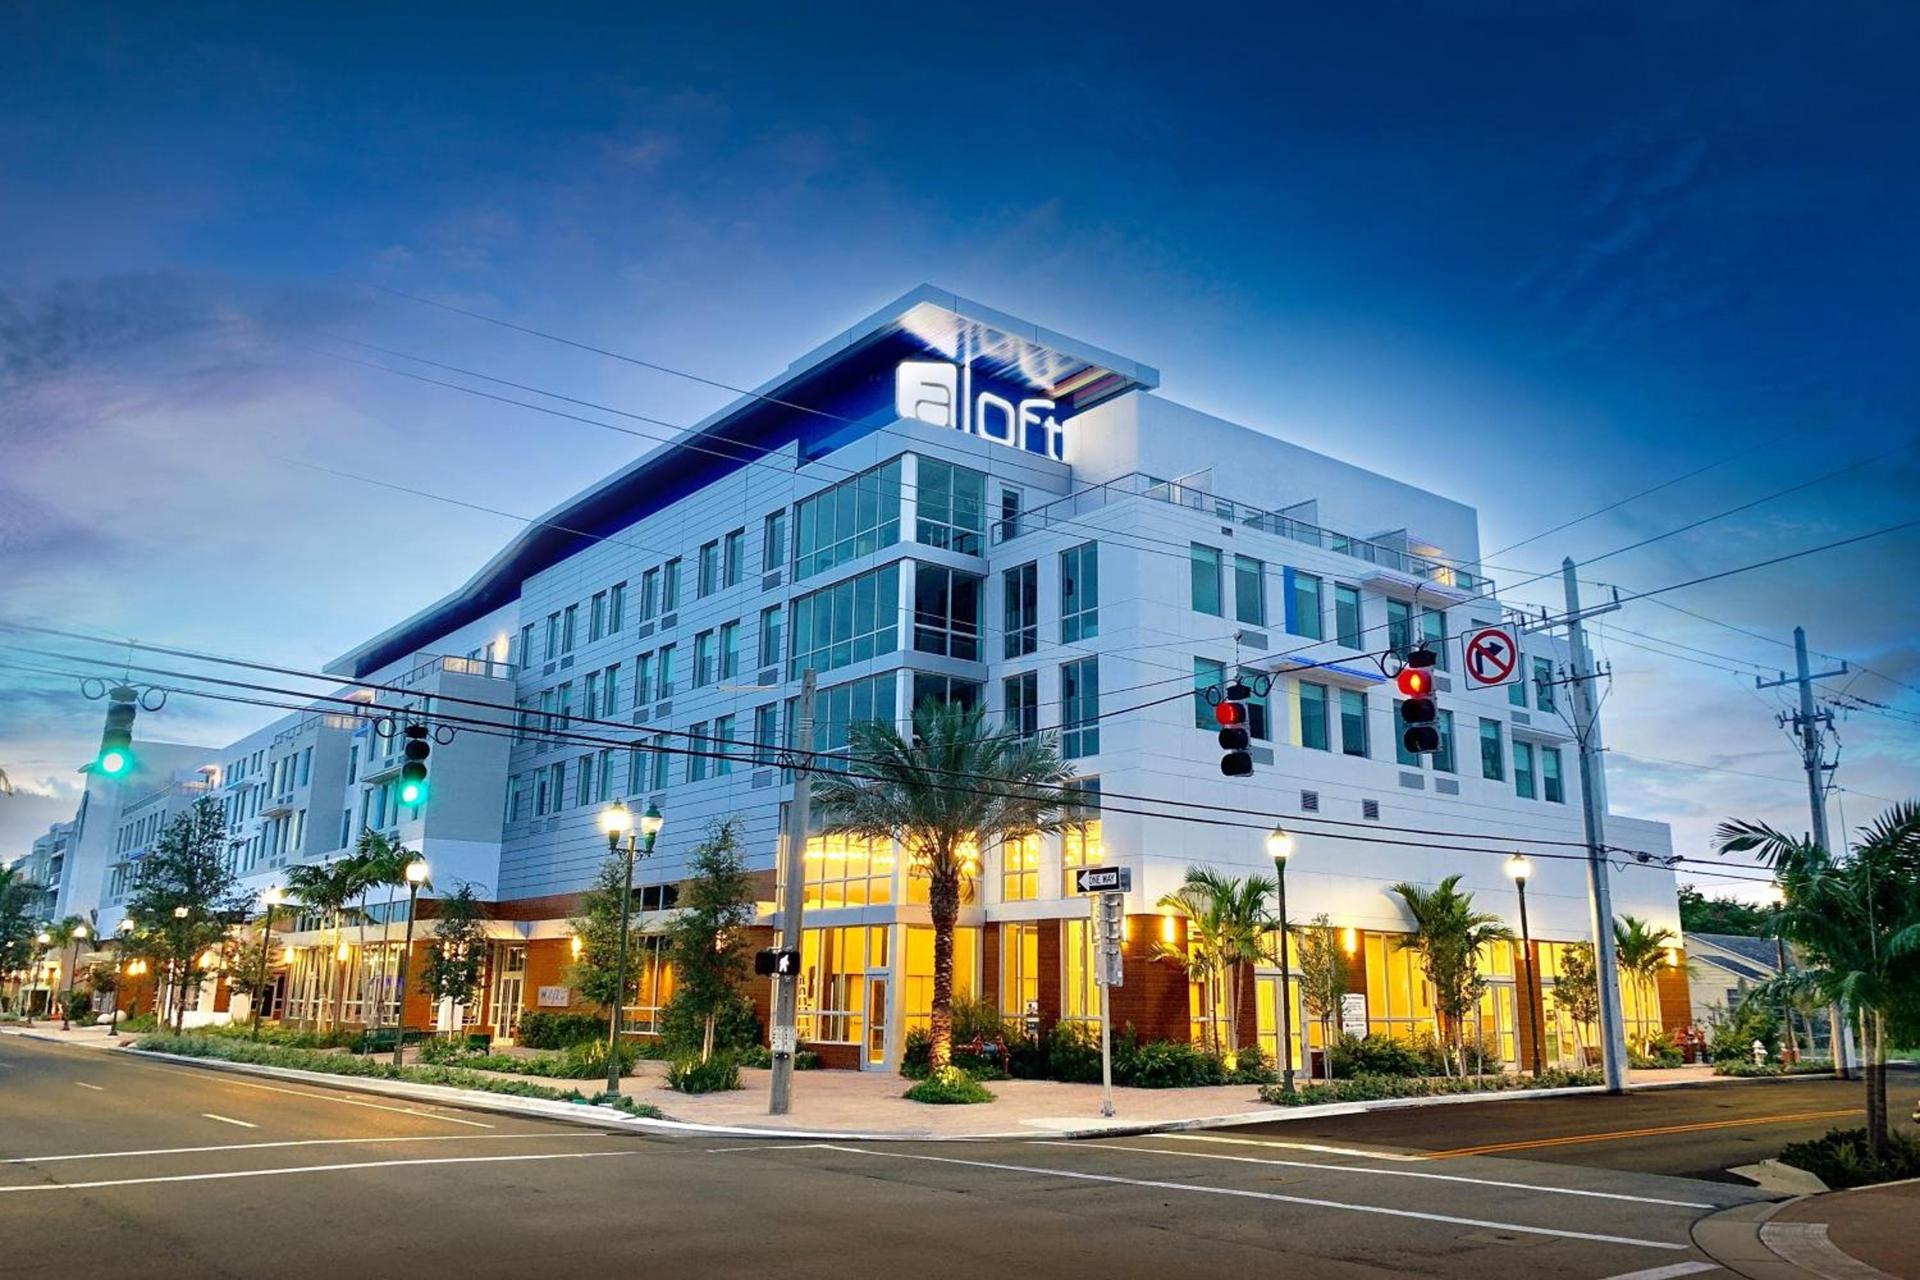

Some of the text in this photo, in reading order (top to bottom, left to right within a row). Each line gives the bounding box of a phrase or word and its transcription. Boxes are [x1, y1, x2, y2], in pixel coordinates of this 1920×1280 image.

[896, 359, 1065, 461] aloft
[1089, 873, 1115, 885] ONE WAY
